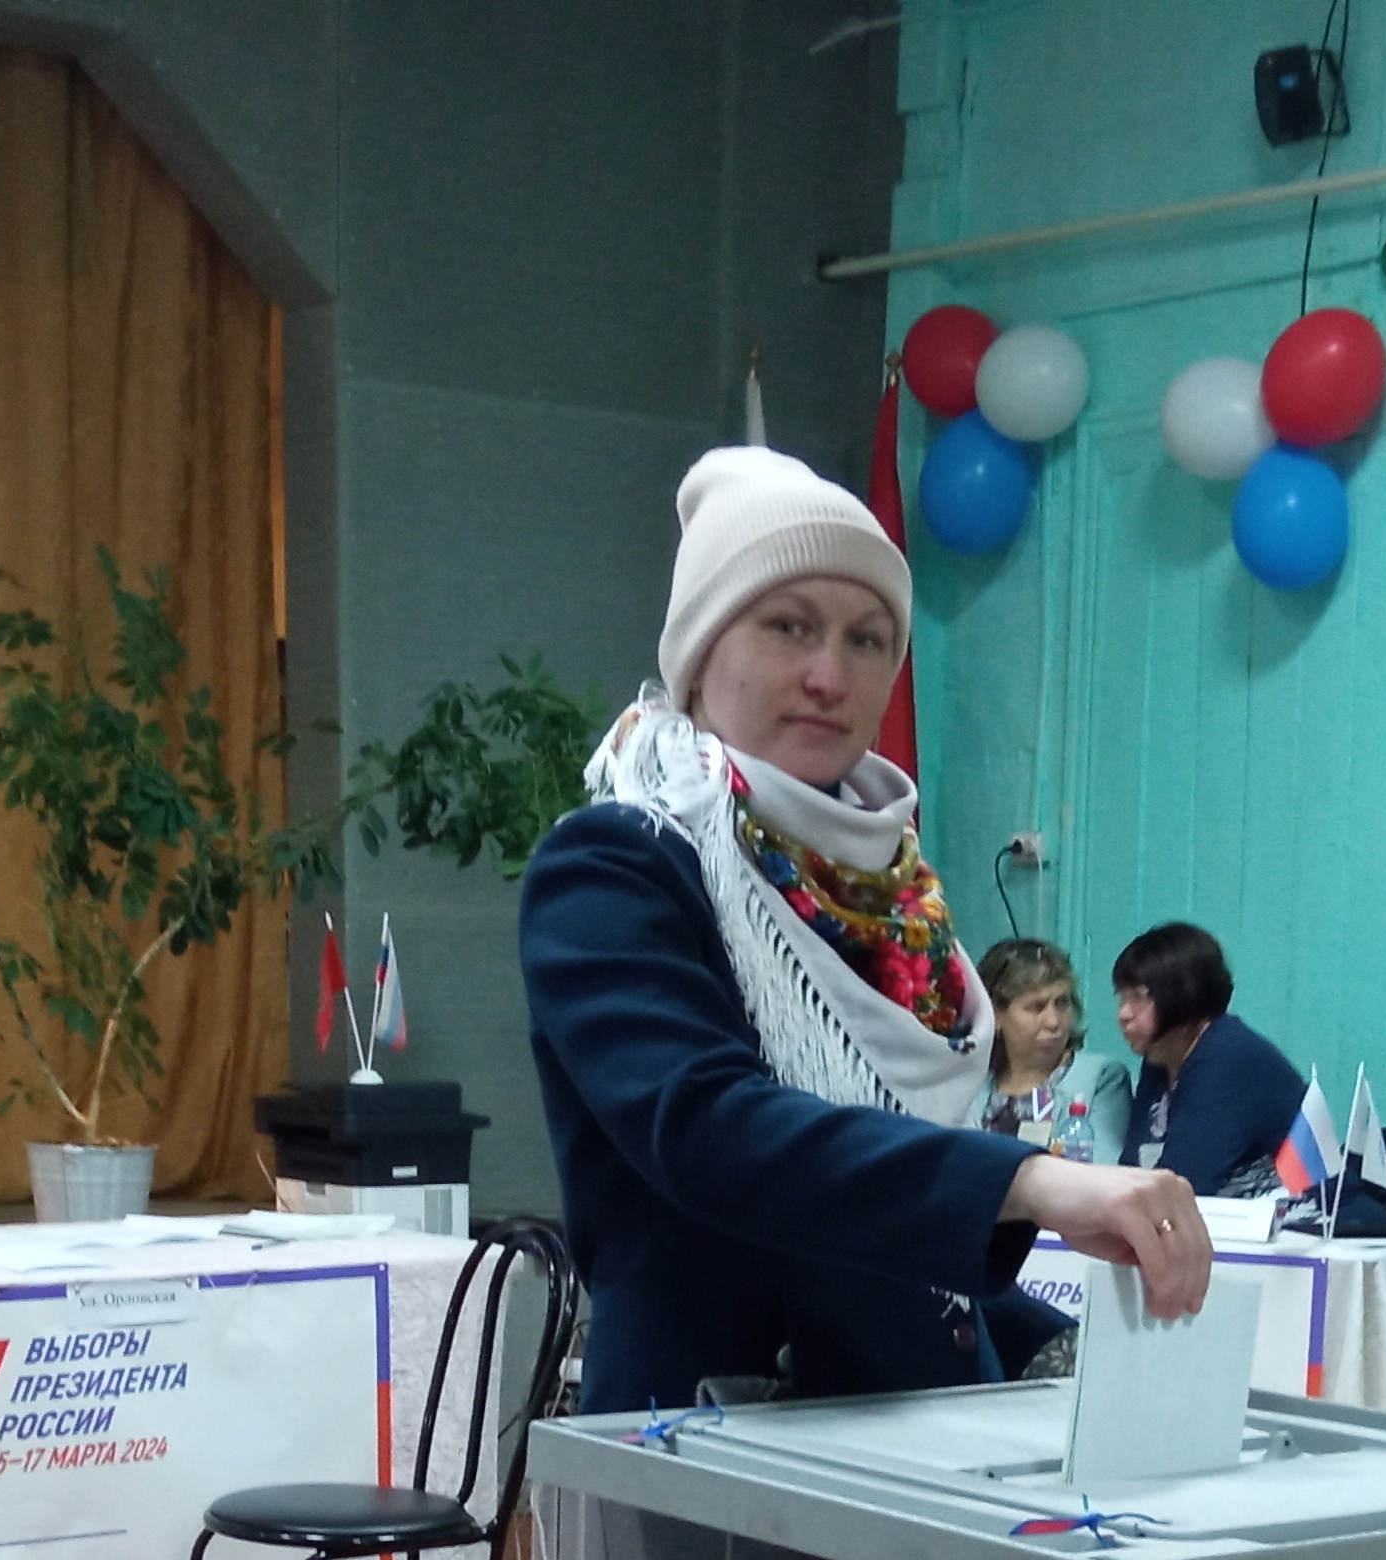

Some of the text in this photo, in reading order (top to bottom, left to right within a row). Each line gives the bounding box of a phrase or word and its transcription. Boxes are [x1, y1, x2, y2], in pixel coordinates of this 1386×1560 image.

[24, 1329, 152, 1365] ВЫБОРЫ
[10, 1362, 188, 1404] ПРЕЗИДЕНТА
[47, 1442, 117, 1469] МАРТА
[120, 1436, 168, 1464] 2024
